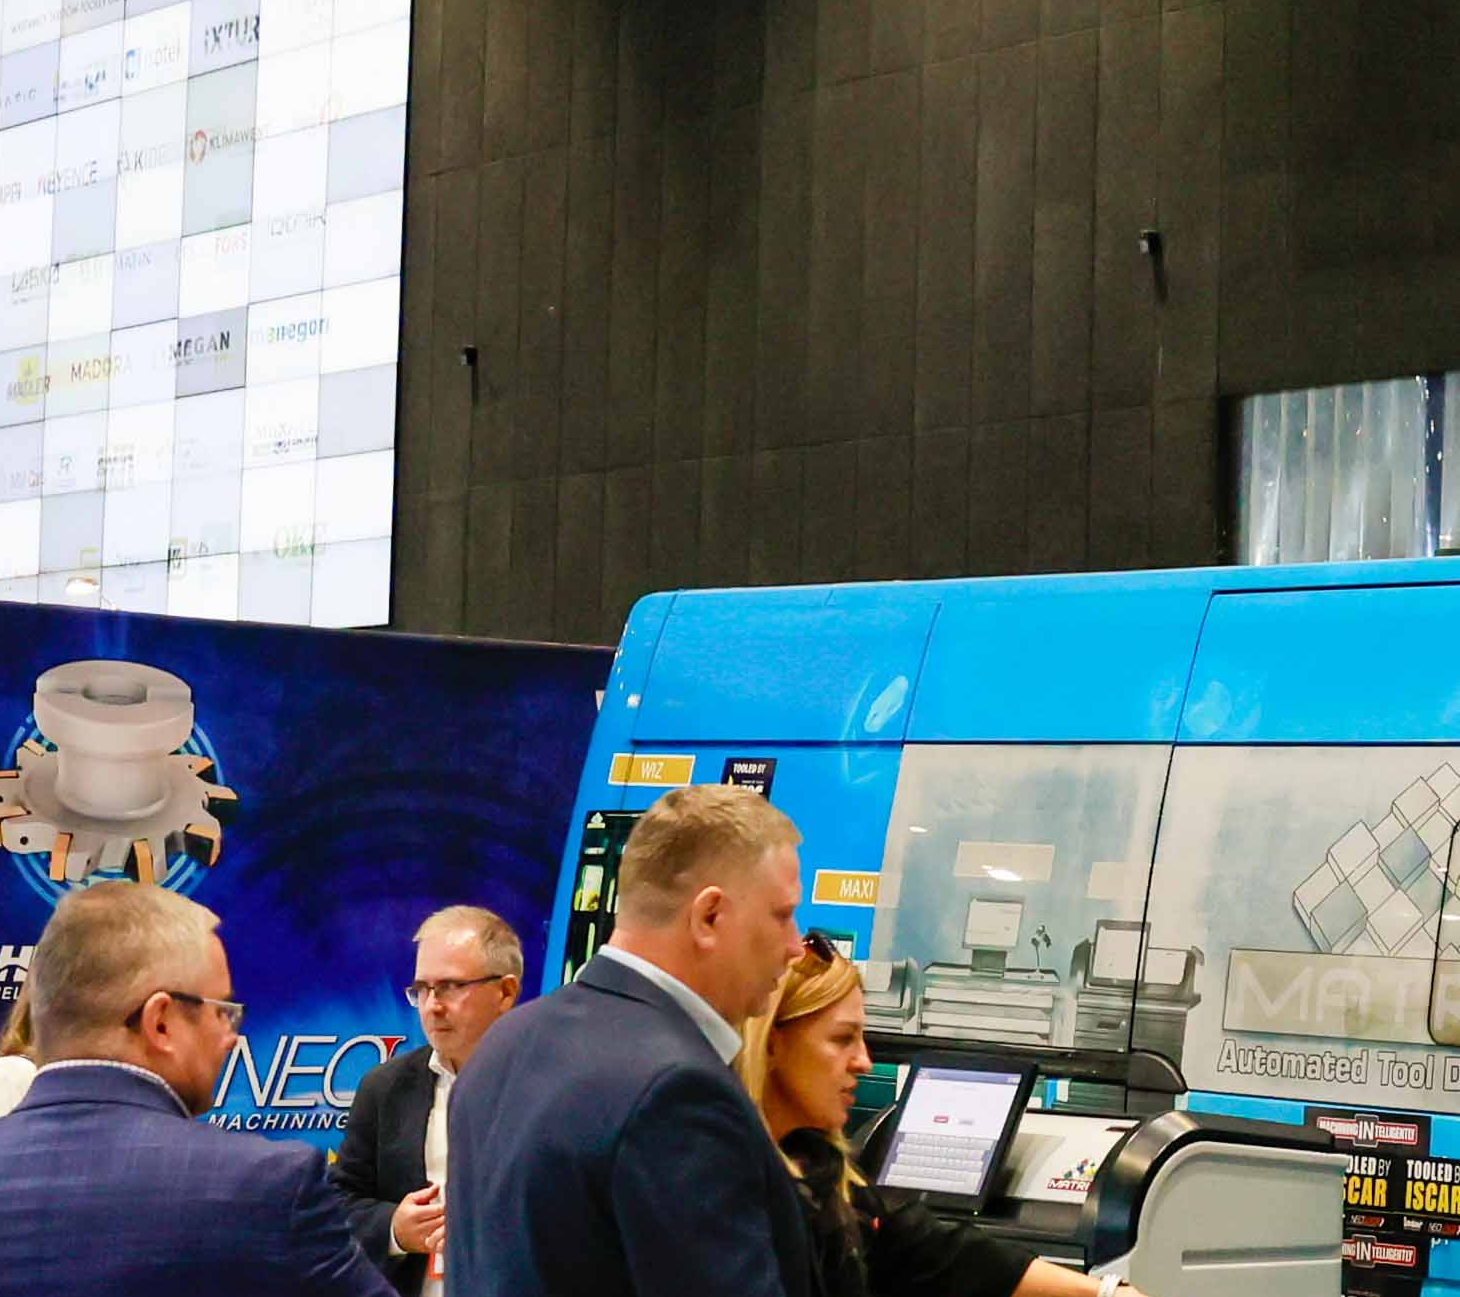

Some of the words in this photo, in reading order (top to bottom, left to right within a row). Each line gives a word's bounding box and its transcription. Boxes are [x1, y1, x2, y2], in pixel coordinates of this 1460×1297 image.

[641, 761, 664, 780] WIZ
[840, 878, 874, 899] MAXI
[1217, 1038, 1369, 1085] Automated
[1377, 1050, 1435, 1090] Tool
[1406, 1159, 1453, 1183] TOOLED
